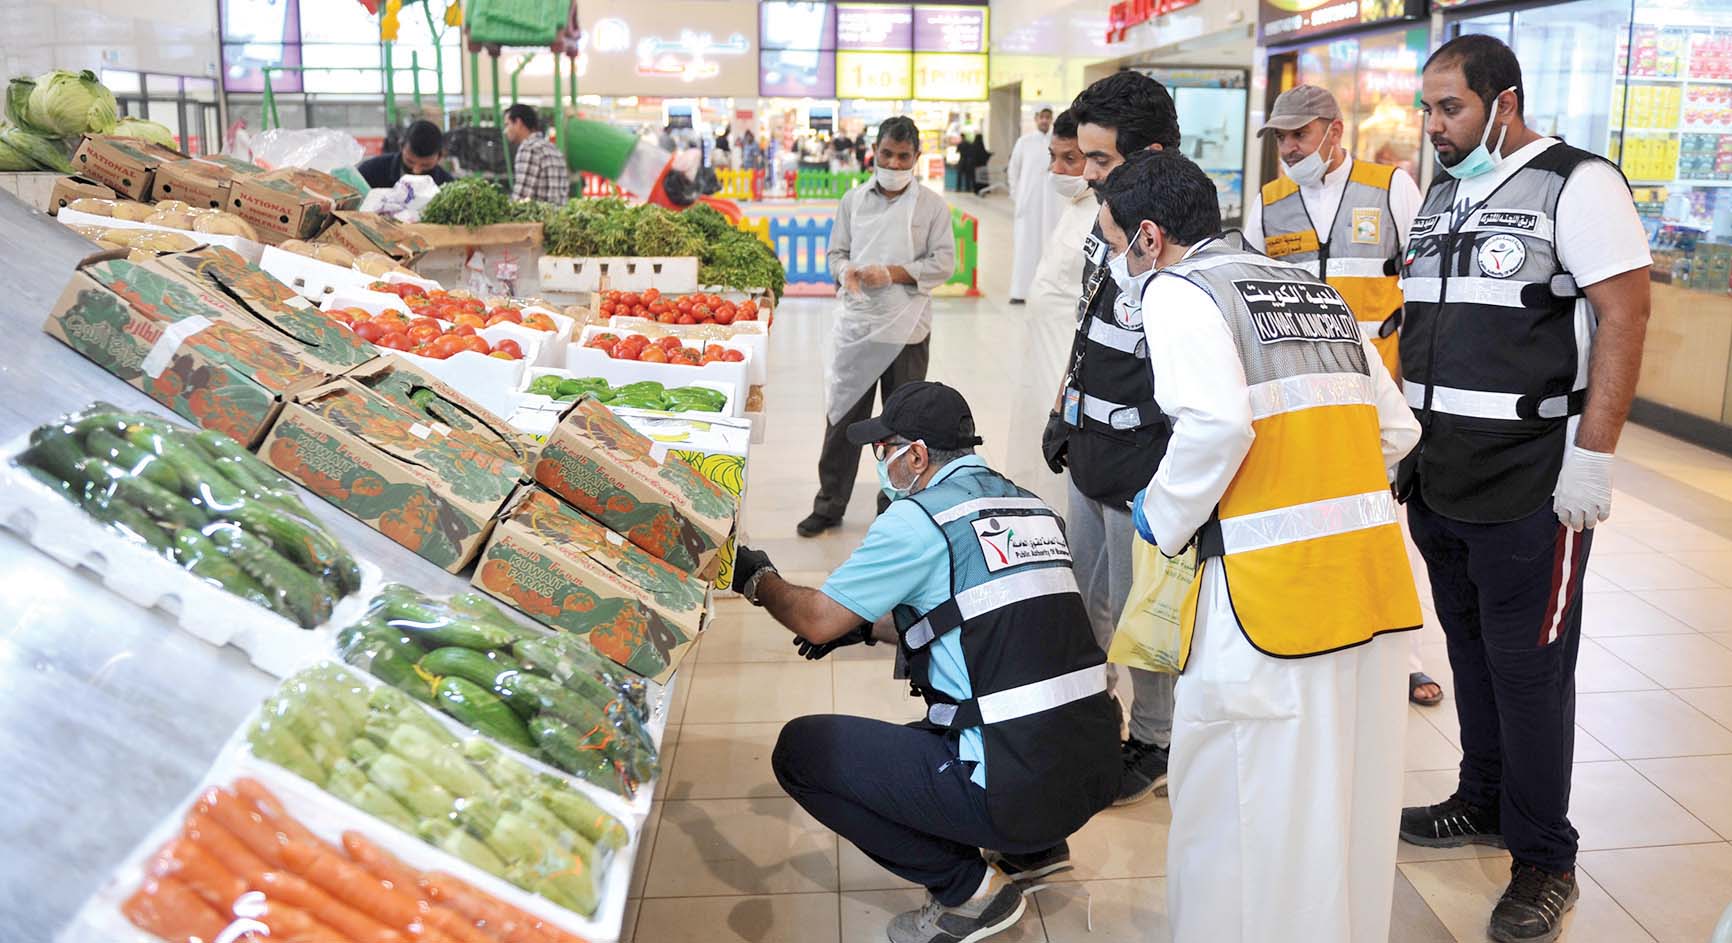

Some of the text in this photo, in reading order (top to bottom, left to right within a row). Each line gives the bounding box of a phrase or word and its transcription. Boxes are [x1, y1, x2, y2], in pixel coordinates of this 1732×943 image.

[86, 146, 137, 178] NATIONAL
[239, 192, 294, 216] NATIONAL
[1243, 283, 1346, 311] بلدية الكويت
[290, 414, 374, 470] Fresh From
[298, 435, 352, 472] KUWAIT
[295, 446, 344, 482] FARMS
[554, 438, 589, 465] Fresh
[596, 463, 626, 490] From
[558, 466, 600, 498] FARMS
[560, 455, 608, 492] KUWAIT
[502, 535, 541, 564] Fresh
[550, 559, 584, 587] From
[509, 553, 564, 590] KUWAIT
[507, 564, 555, 598] FARMS
